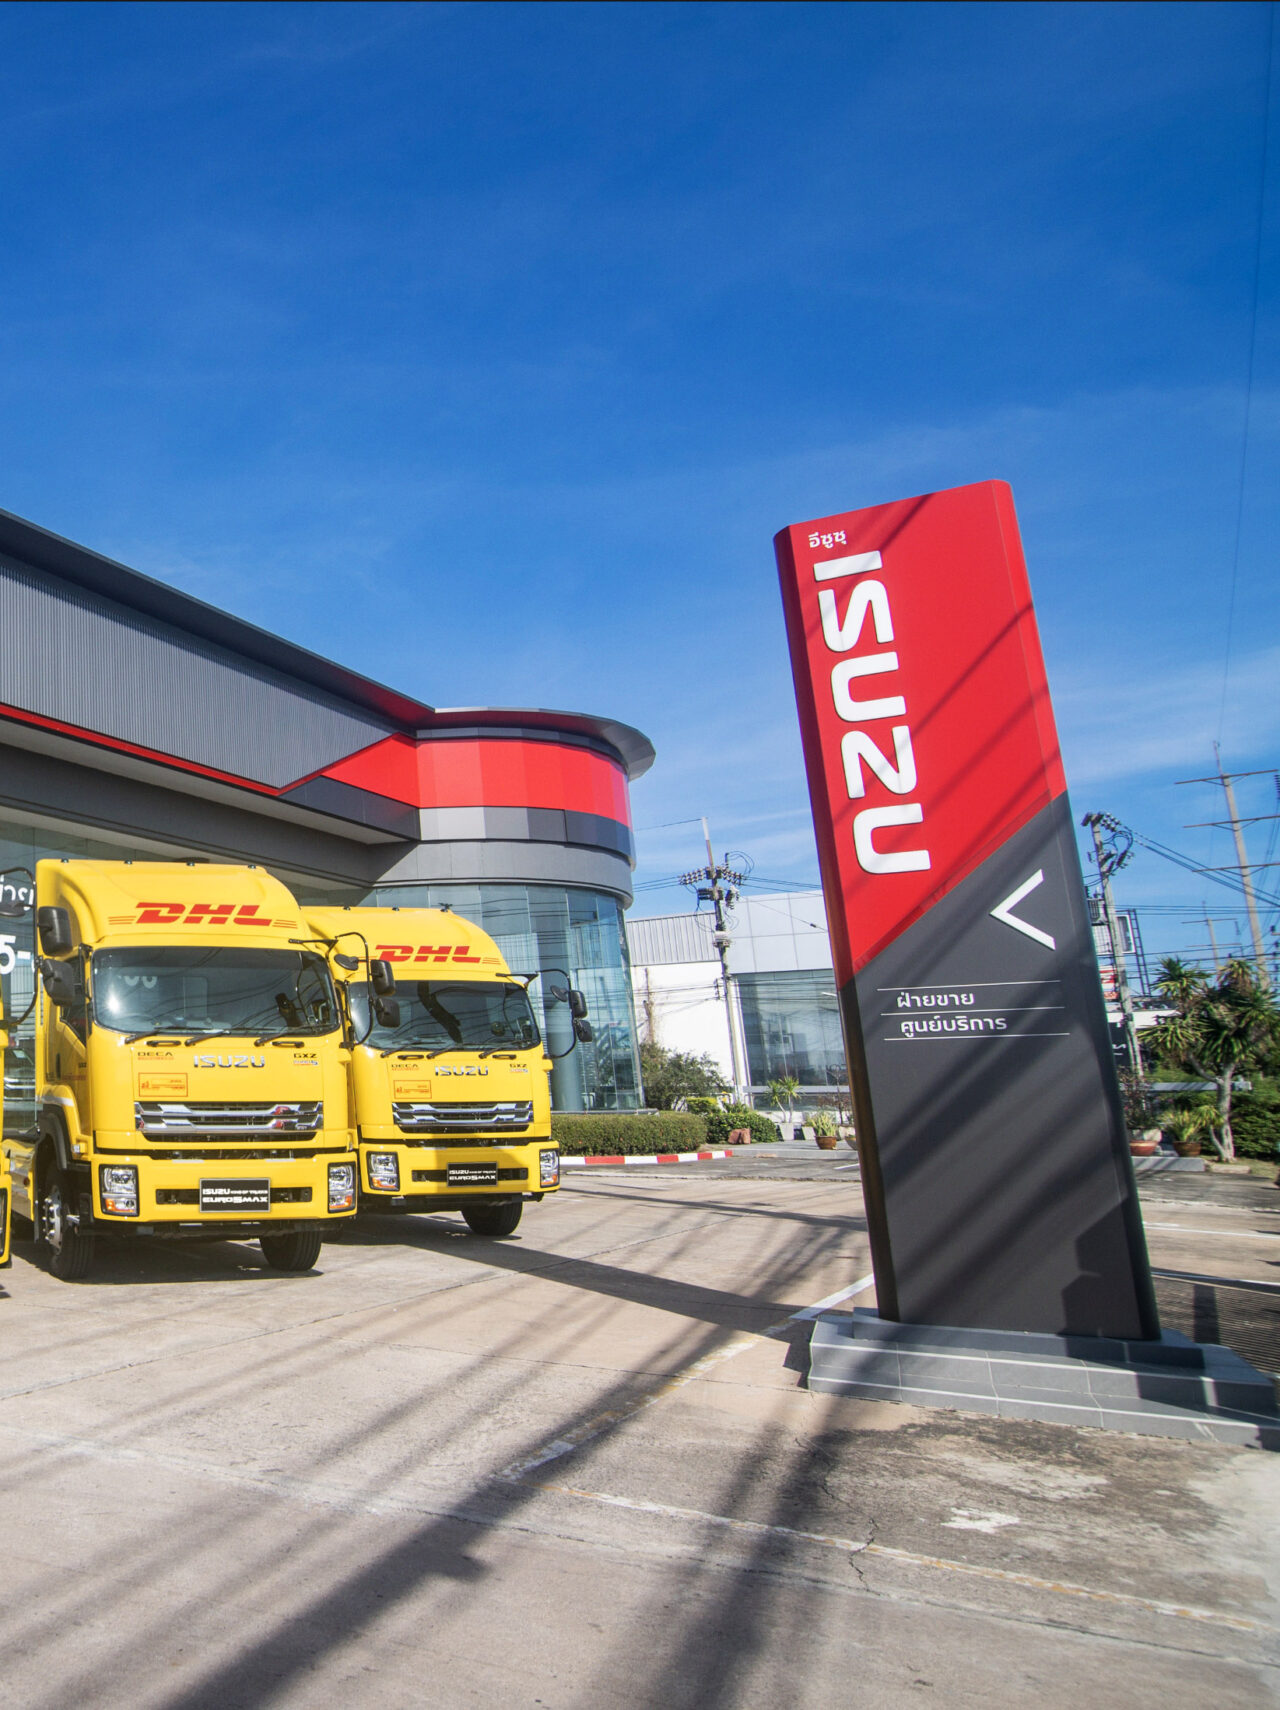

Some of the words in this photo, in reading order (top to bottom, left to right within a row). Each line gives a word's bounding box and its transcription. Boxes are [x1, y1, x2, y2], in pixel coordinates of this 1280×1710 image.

[813, 550, 931, 875] ISUZU
[134, 902, 272, 928] DHL
[375, 945, 482, 964] DHL
[897, 991, 975, 1008] ฝ่ายขาย
[901, 1015, 1007, 1038] ศูนย์บริการ
[193, 1055, 266, 1068] ISUZU
[434, 1065, 489, 1076] ISUZU
